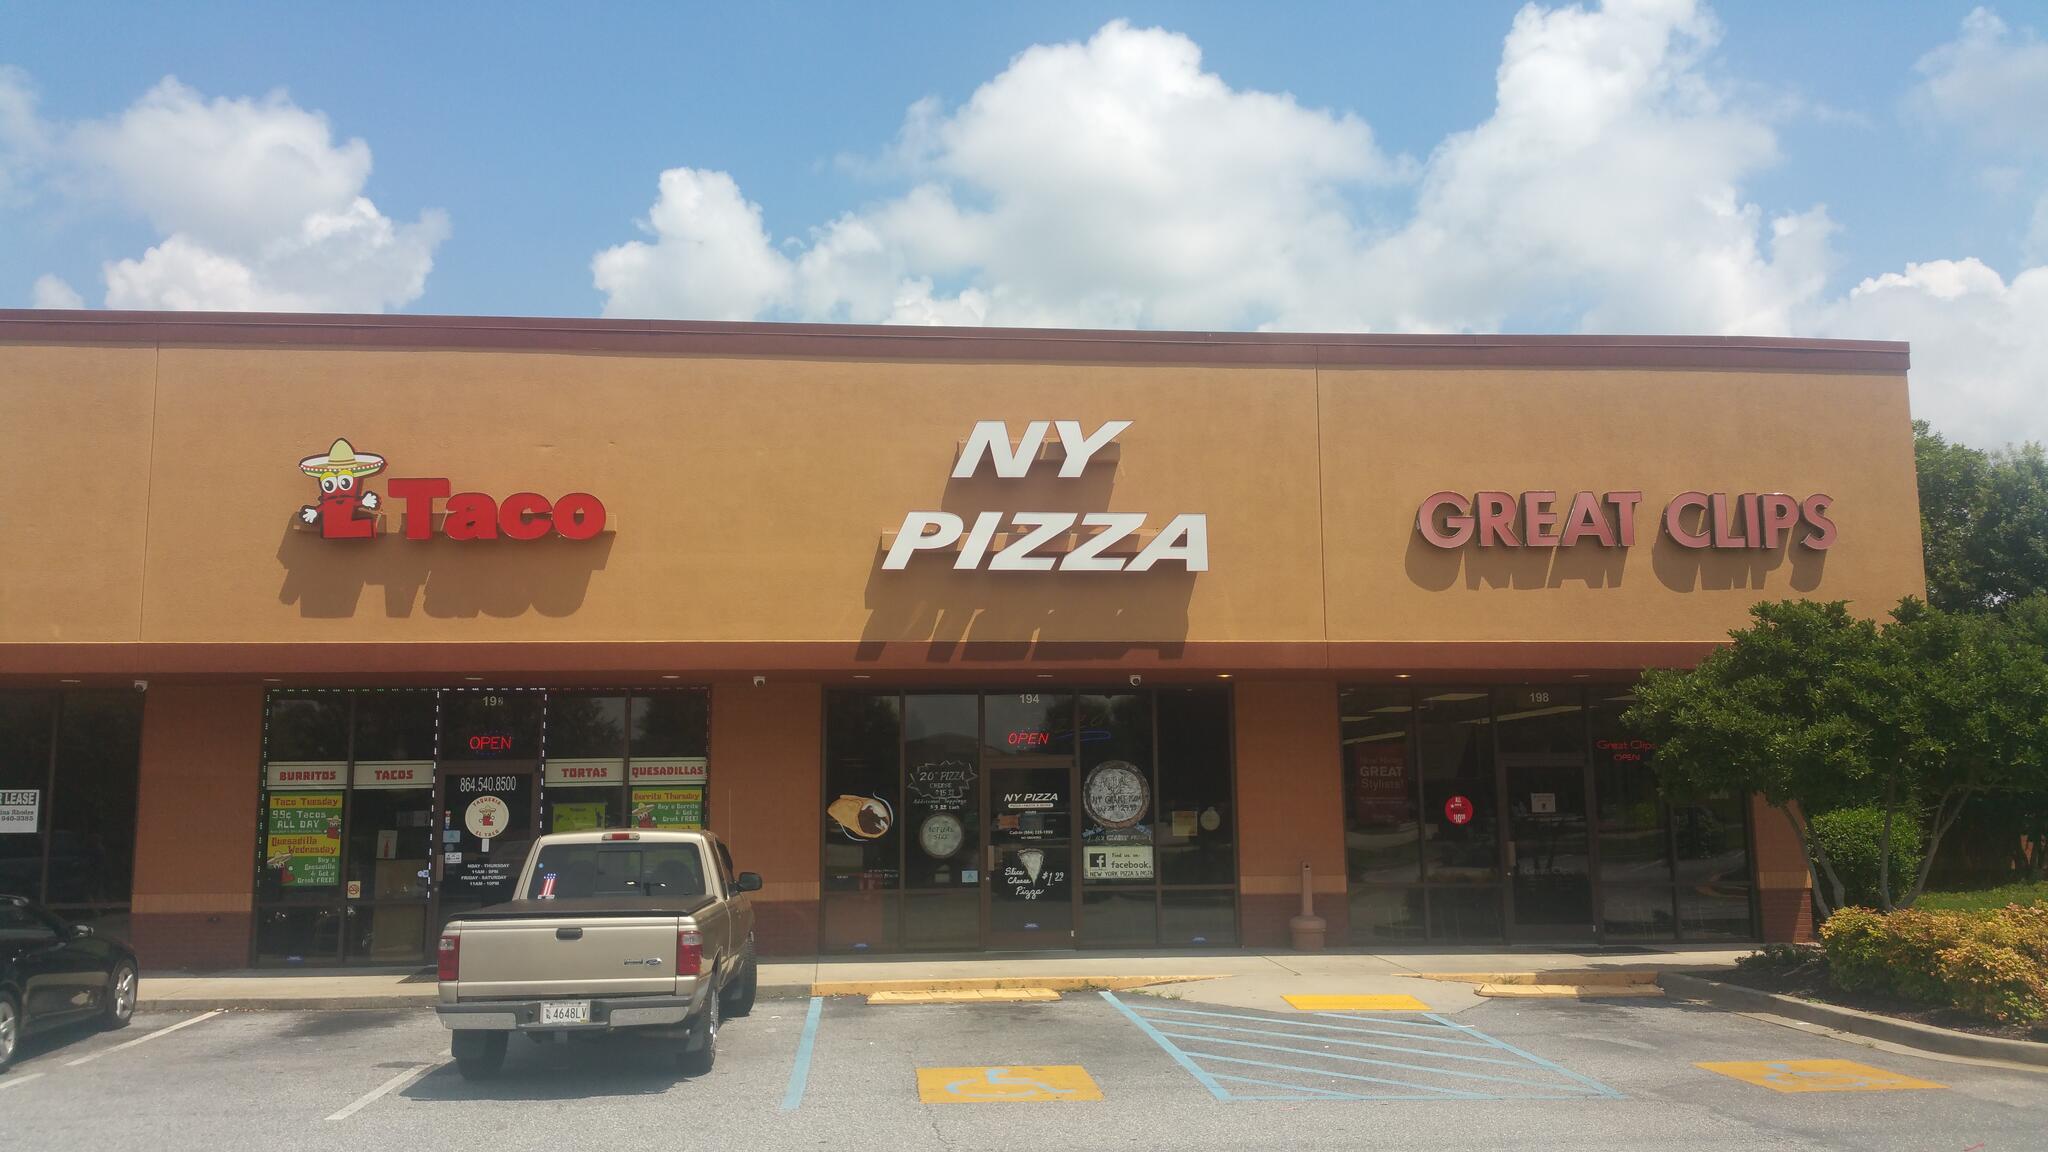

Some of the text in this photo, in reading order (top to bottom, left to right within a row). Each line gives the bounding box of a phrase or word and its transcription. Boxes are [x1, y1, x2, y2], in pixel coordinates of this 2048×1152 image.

[951, 420, 1134, 478] NY
[388, 477, 606, 540] Taco
[1417, 491, 1838, 550] GREAT CLIPS
[881, 511, 1208, 572] PIZZA
[1020, 694, 1040, 704] 194
[1529, 692, 1549, 702] 198
[469, 736, 512, 750] OPEN
[1008, 732, 1049, 745] OPEN
[279, 771, 337, 781] BURRITOS
[374, 770, 414, 780] TACOS
[561, 768, 608, 778] TORTAS
[631, 766, 704, 778] QUESADILLAS
[940, 771, 965, 781] PIZZA
[1360, 766, 1404, 777] GREAT
[460, 776, 516, 792] 864.540.8500
[5, 793, 34, 804] LEASE
[273, 798, 338, 806] Taco Tuesday
[1003, 793, 1058, 802] NY PIZZA
[296, 811, 327, 819] Tacos
[277, 820, 319, 829] ALL DAY
[1005, 867, 1024, 875] Slice
[1008, 876, 1031, 884] Cheese
[1015, 886, 1044, 900] Pizza
